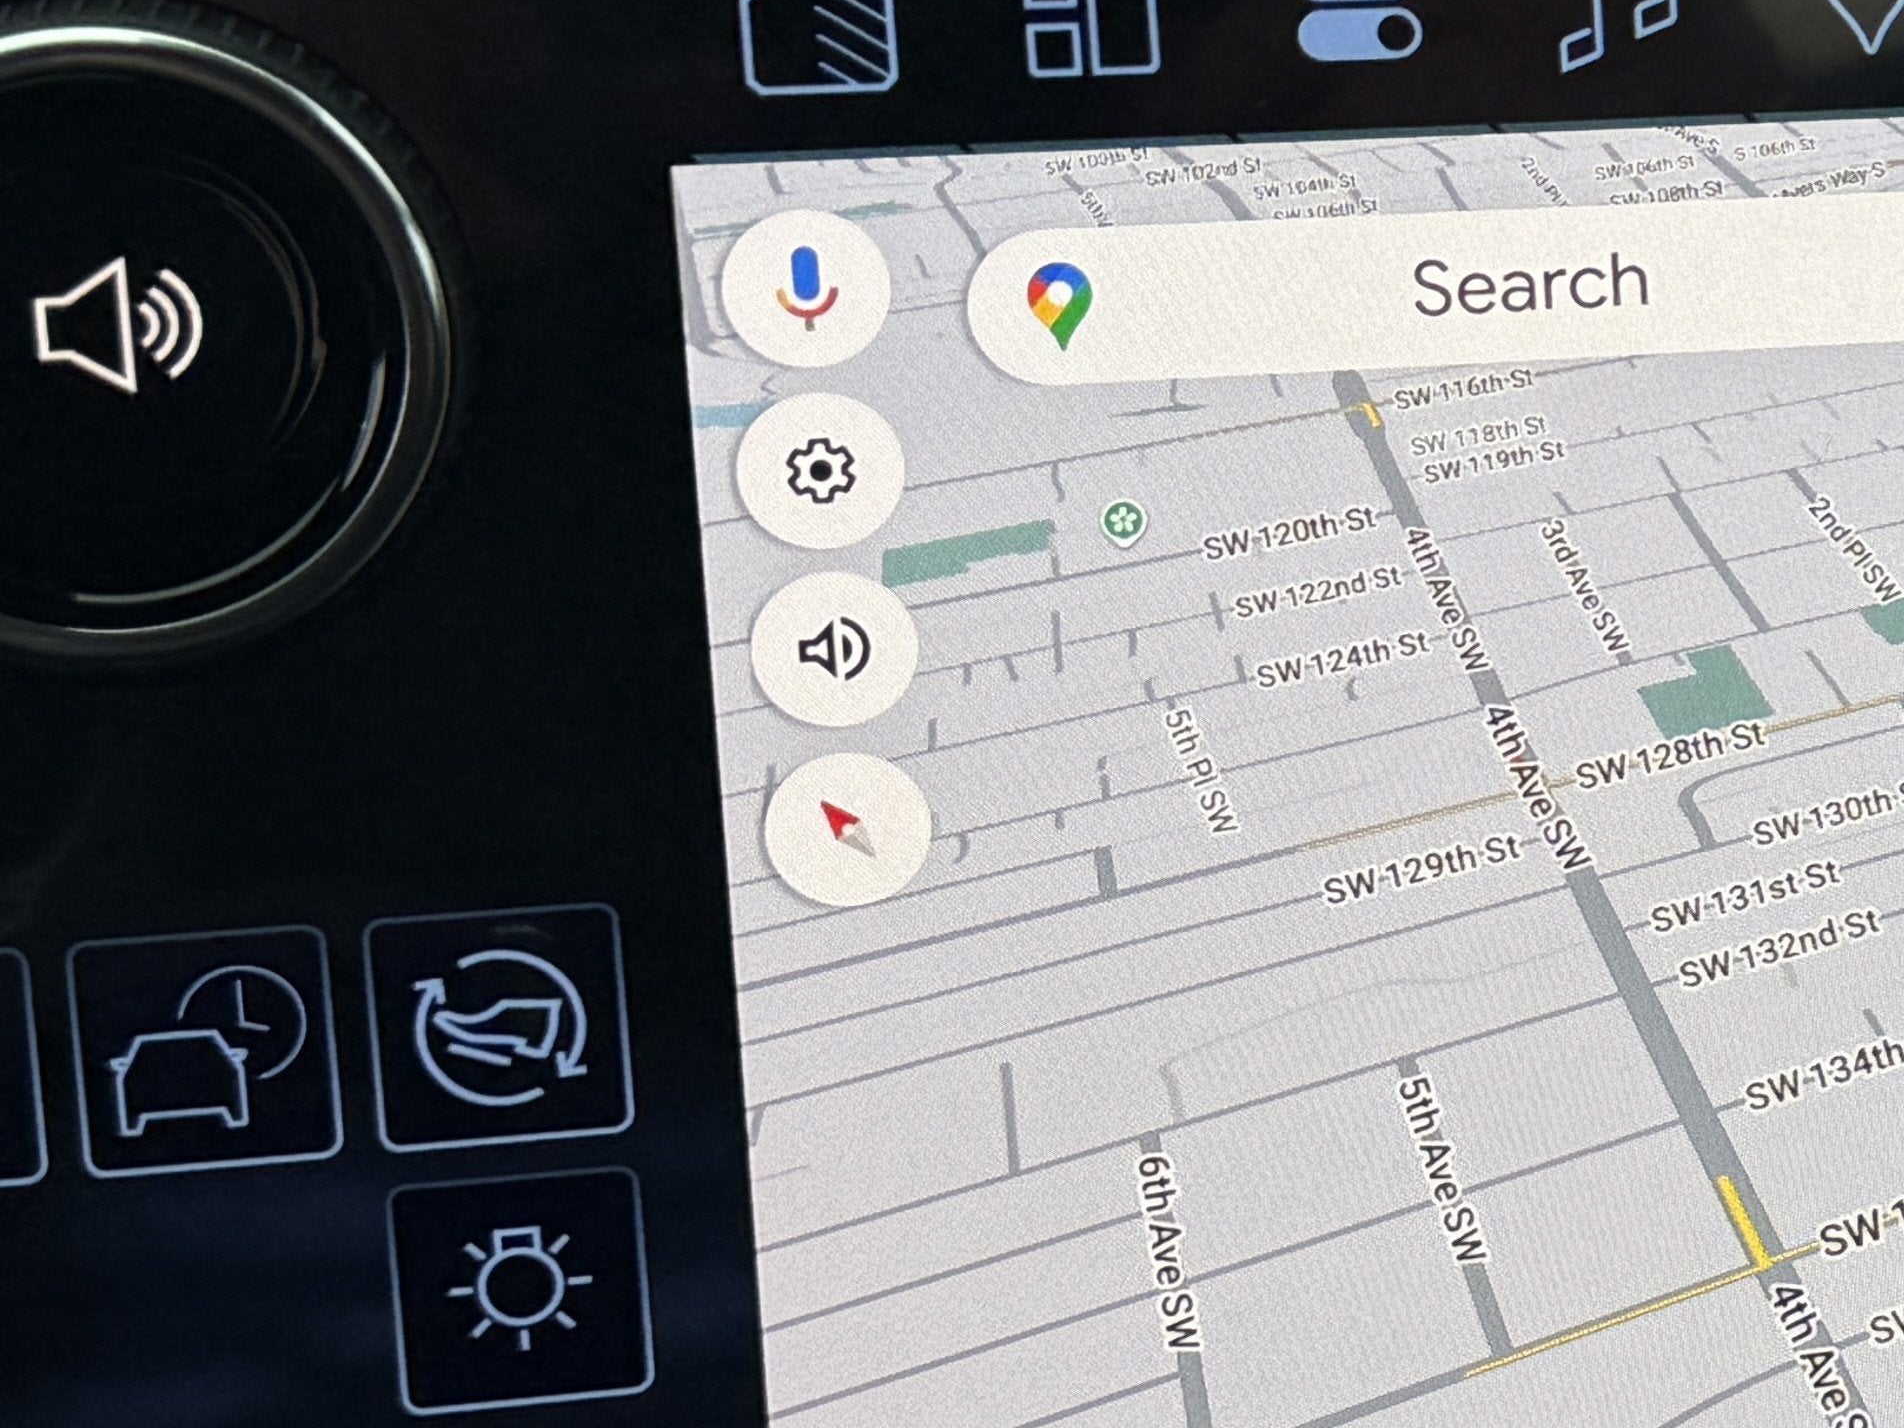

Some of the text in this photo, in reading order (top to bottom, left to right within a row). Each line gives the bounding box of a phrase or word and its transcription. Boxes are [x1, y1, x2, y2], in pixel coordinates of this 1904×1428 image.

[1414, 252, 1648, 317] Search
[1394, 369, 1533, 410] SW 116th St
[1203, 507, 1376, 560] SW 120th St
[1257, 632, 1427, 688] SW 124th St
[1487, 707, 1591, 869] 4th Ave SW
[1576, 723, 1765, 789] SW 128th St
[1753, 812, 1799, 845] SW
[1809, 789, 1892, 829] 130th
[1324, 836, 1519, 904] SW 129th St
[1651, 861, 1840, 932] SW 131st St
[1679, 910, 1879, 987] SW 132nd St
[1746, 1069, 1799, 1110] SW
[1399, 1078, 1486, 1261] 5th Ave SW
[1139, 1157, 1200, 1347] 6th Ave SW
[1820, 1210, 1880, 1256] SW
[1774, 1287, 1817, 1343] 4th
[1800, 1351, 1846, 1411] Ave
